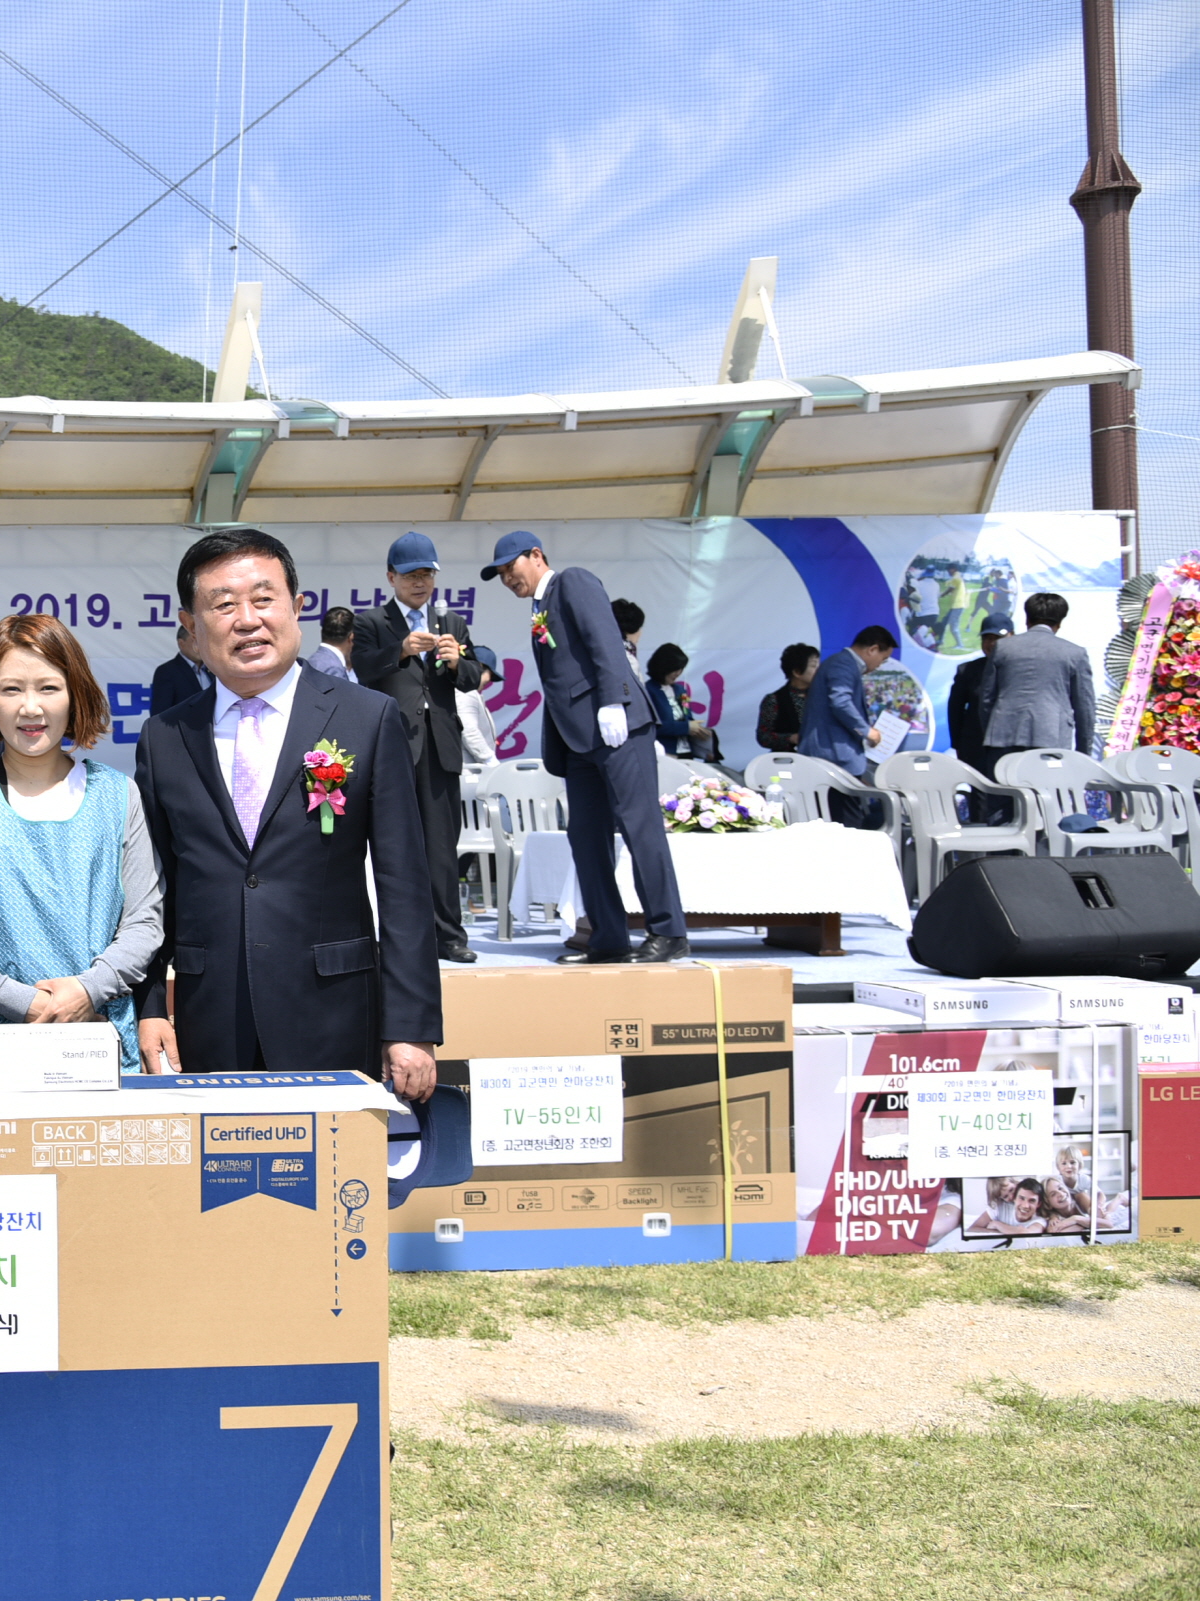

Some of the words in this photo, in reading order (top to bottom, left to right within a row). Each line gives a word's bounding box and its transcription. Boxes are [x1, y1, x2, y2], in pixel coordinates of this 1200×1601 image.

[933, 1000, 989, 1010] SAMSUNG
[1069, 998, 1124, 1009] SAMSUNG
[609, 1024, 638, 1035] 후면
[681, 1028, 717, 1039] ULTRA
[737, 1026, 759, 1037] LED
[761, 1026, 775, 1036] TV
[609, 1037, 638, 1048] 주의
[62, 1051, 84, 1059] Stand
[90, 1050, 108, 1059] PIED
[889, 1054, 960, 1073] 101.6cm
[175, 1075, 337, 1085] SAMSUNG
[480, 1078, 511, 1088] 제30회
[518, 1077, 557, 1088] 고군면민
[563, 1076, 614, 1087] 한마당잔치
[917, 1092, 947, 1103] 제30회
[997, 1089, 1046, 1101] 한마당잔치
[1150, 1086, 1173, 1102] LG
[503, 1105, 601, 1125] TV-55인치
[938, 1112, 1032, 1131] TV-40인치
[43, 1125, 87, 1140] BACK
[210, 1127, 273, 1141] Certified
[275, 1127, 307, 1140] UHD
[204, 1161, 218, 1172] 4K
[284, 1164, 304, 1172] HD
[835, 1194, 928, 1217] DIGITAL
[835, 1220, 881, 1242] LED
[887, 1219, 919, 1240] TV
